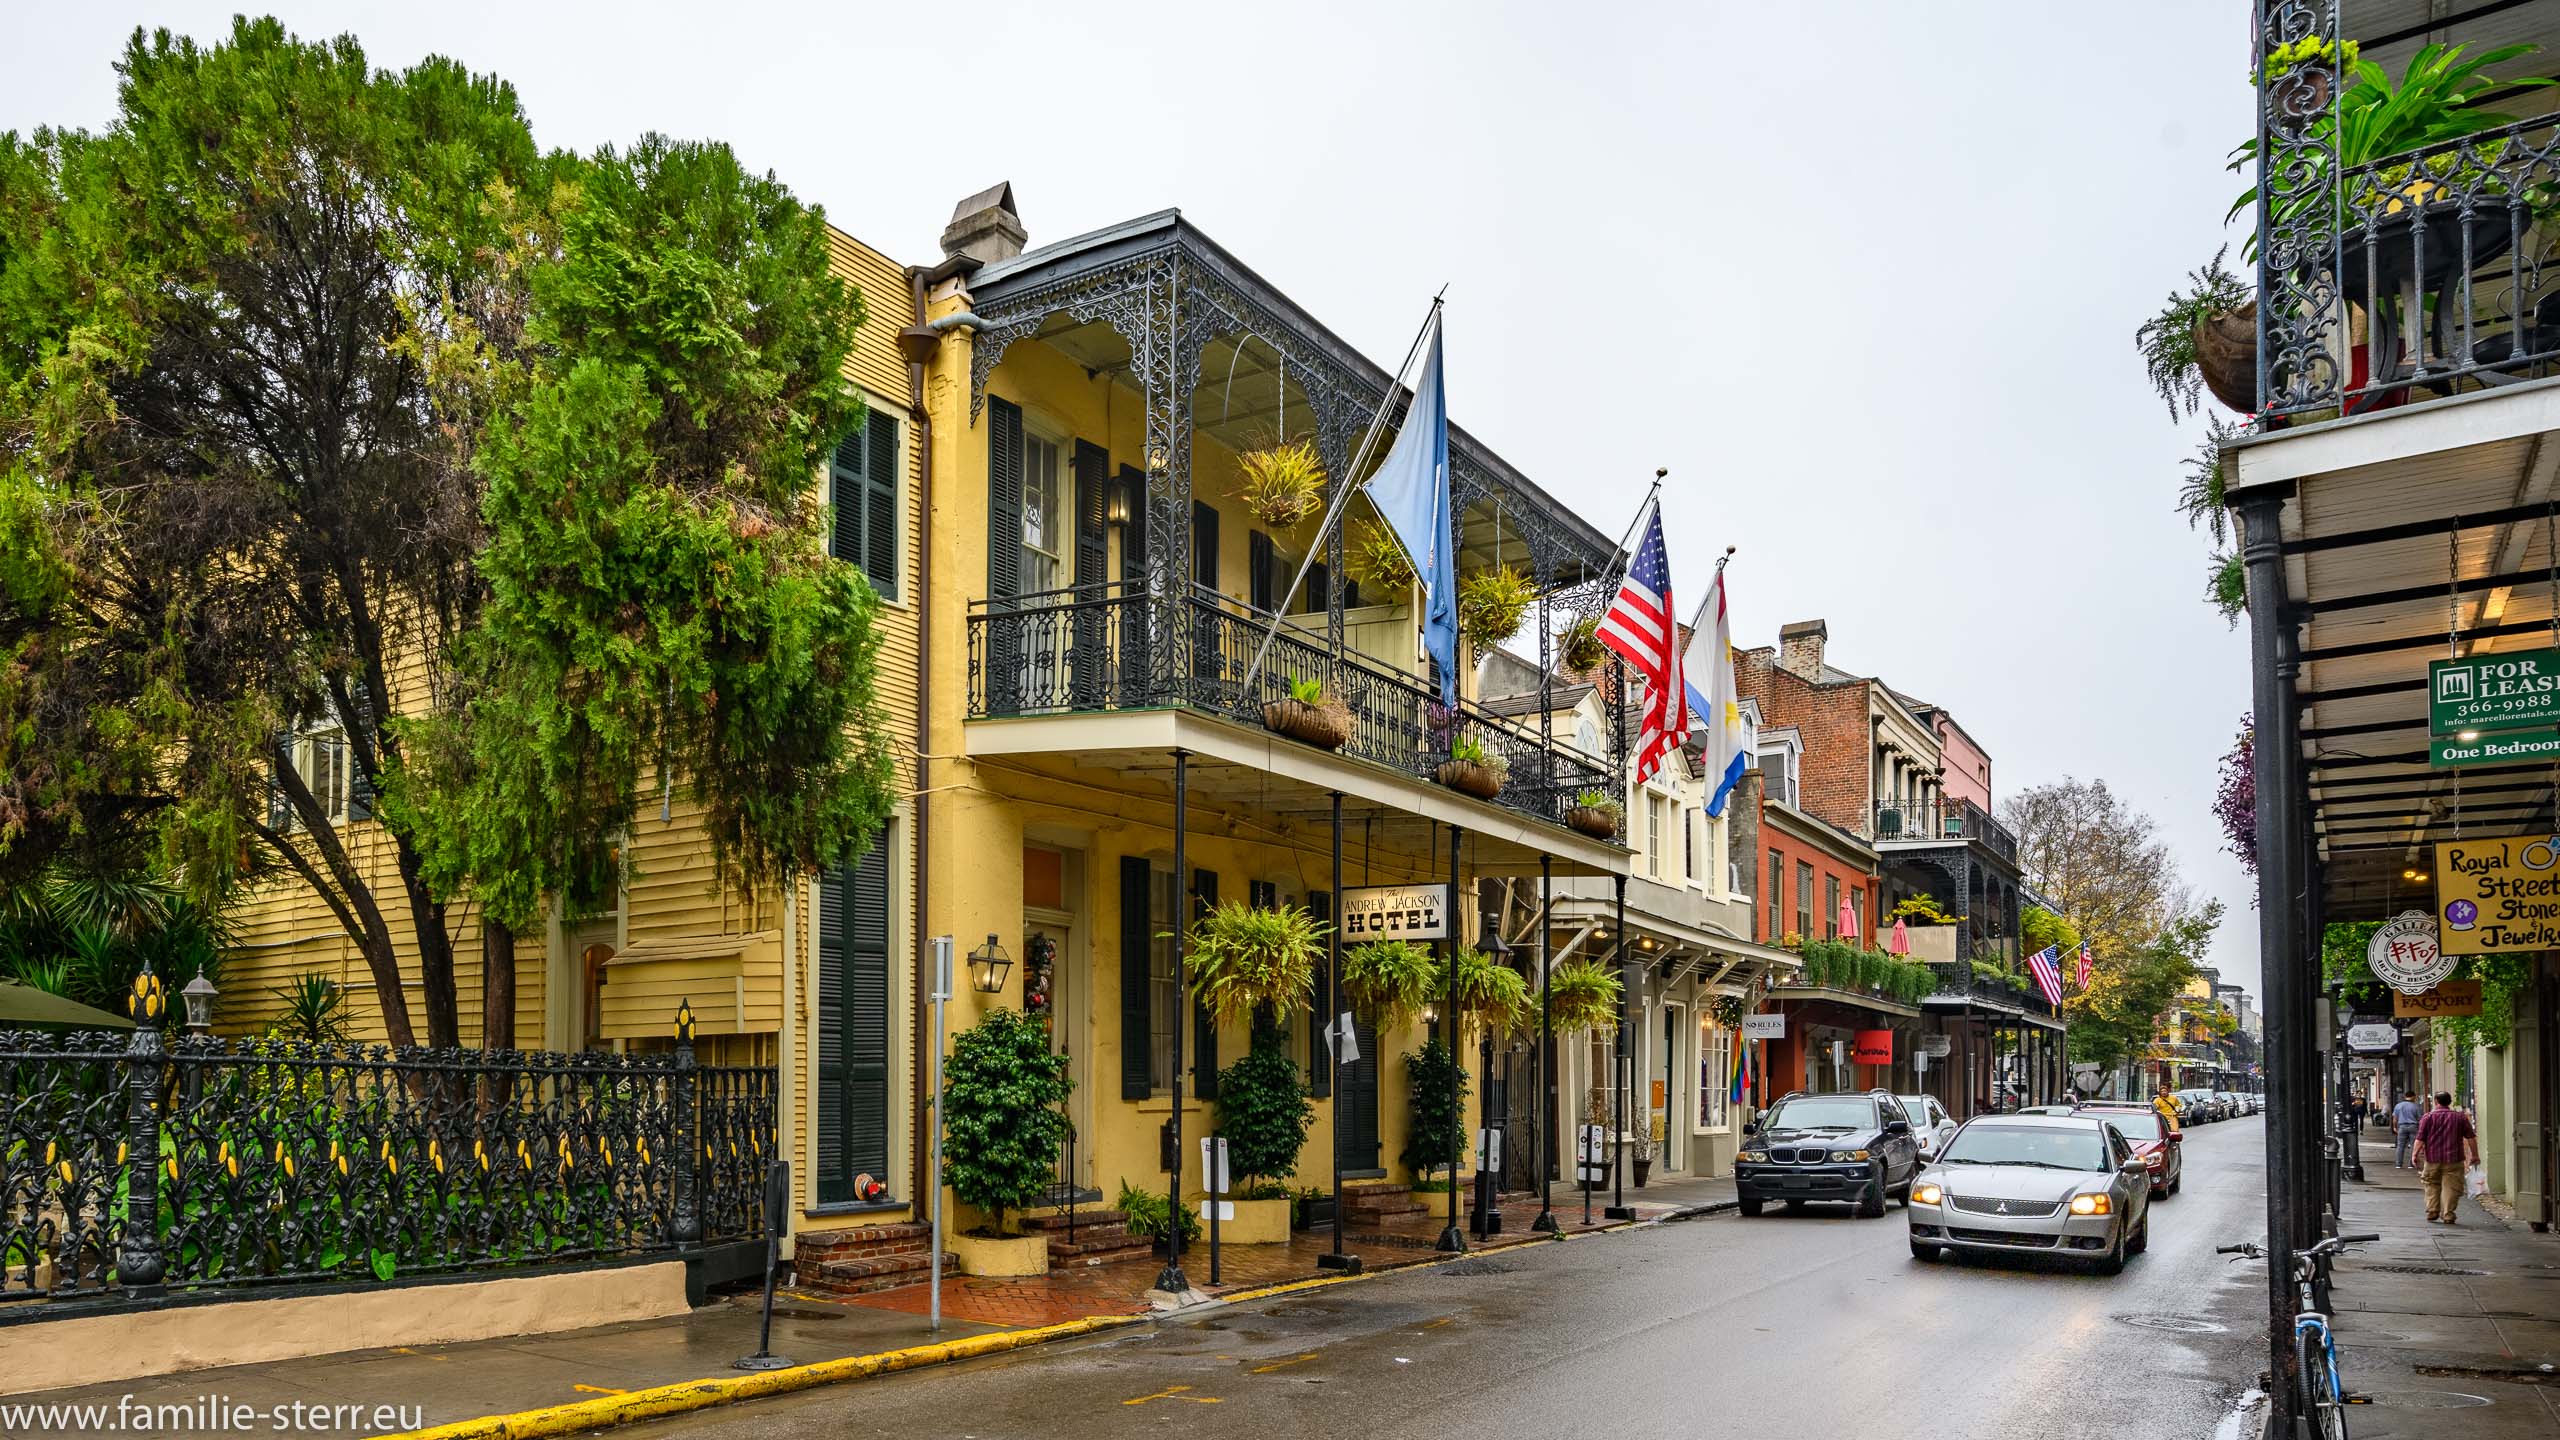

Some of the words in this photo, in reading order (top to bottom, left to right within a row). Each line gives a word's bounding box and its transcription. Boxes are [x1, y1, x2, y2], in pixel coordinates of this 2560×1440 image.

[2479, 661, 2539, 680] FOR
[2458, 694, 2551, 716] 366-9988
[2445, 719, 2467, 727] info:
[2470, 710, 2560, 724] marcellorentals.co
[2442, 748, 2480, 760] One
[2449, 843, 2510, 877] Royal
[1386, 889, 1400, 897] The
[1344, 898, 1386, 912] ANDREW
[1392, 894, 1440, 910] JACKSON
[2496, 899, 2560, 920] Stone
[1347, 909, 1440, 933] HOTEL
[2385, 922, 2438, 938] GALLER
[2377, 960, 2389, 972] ART
[2390, 972, 2403, 980] BY
[2401, 995, 2473, 1011] FACTORY
